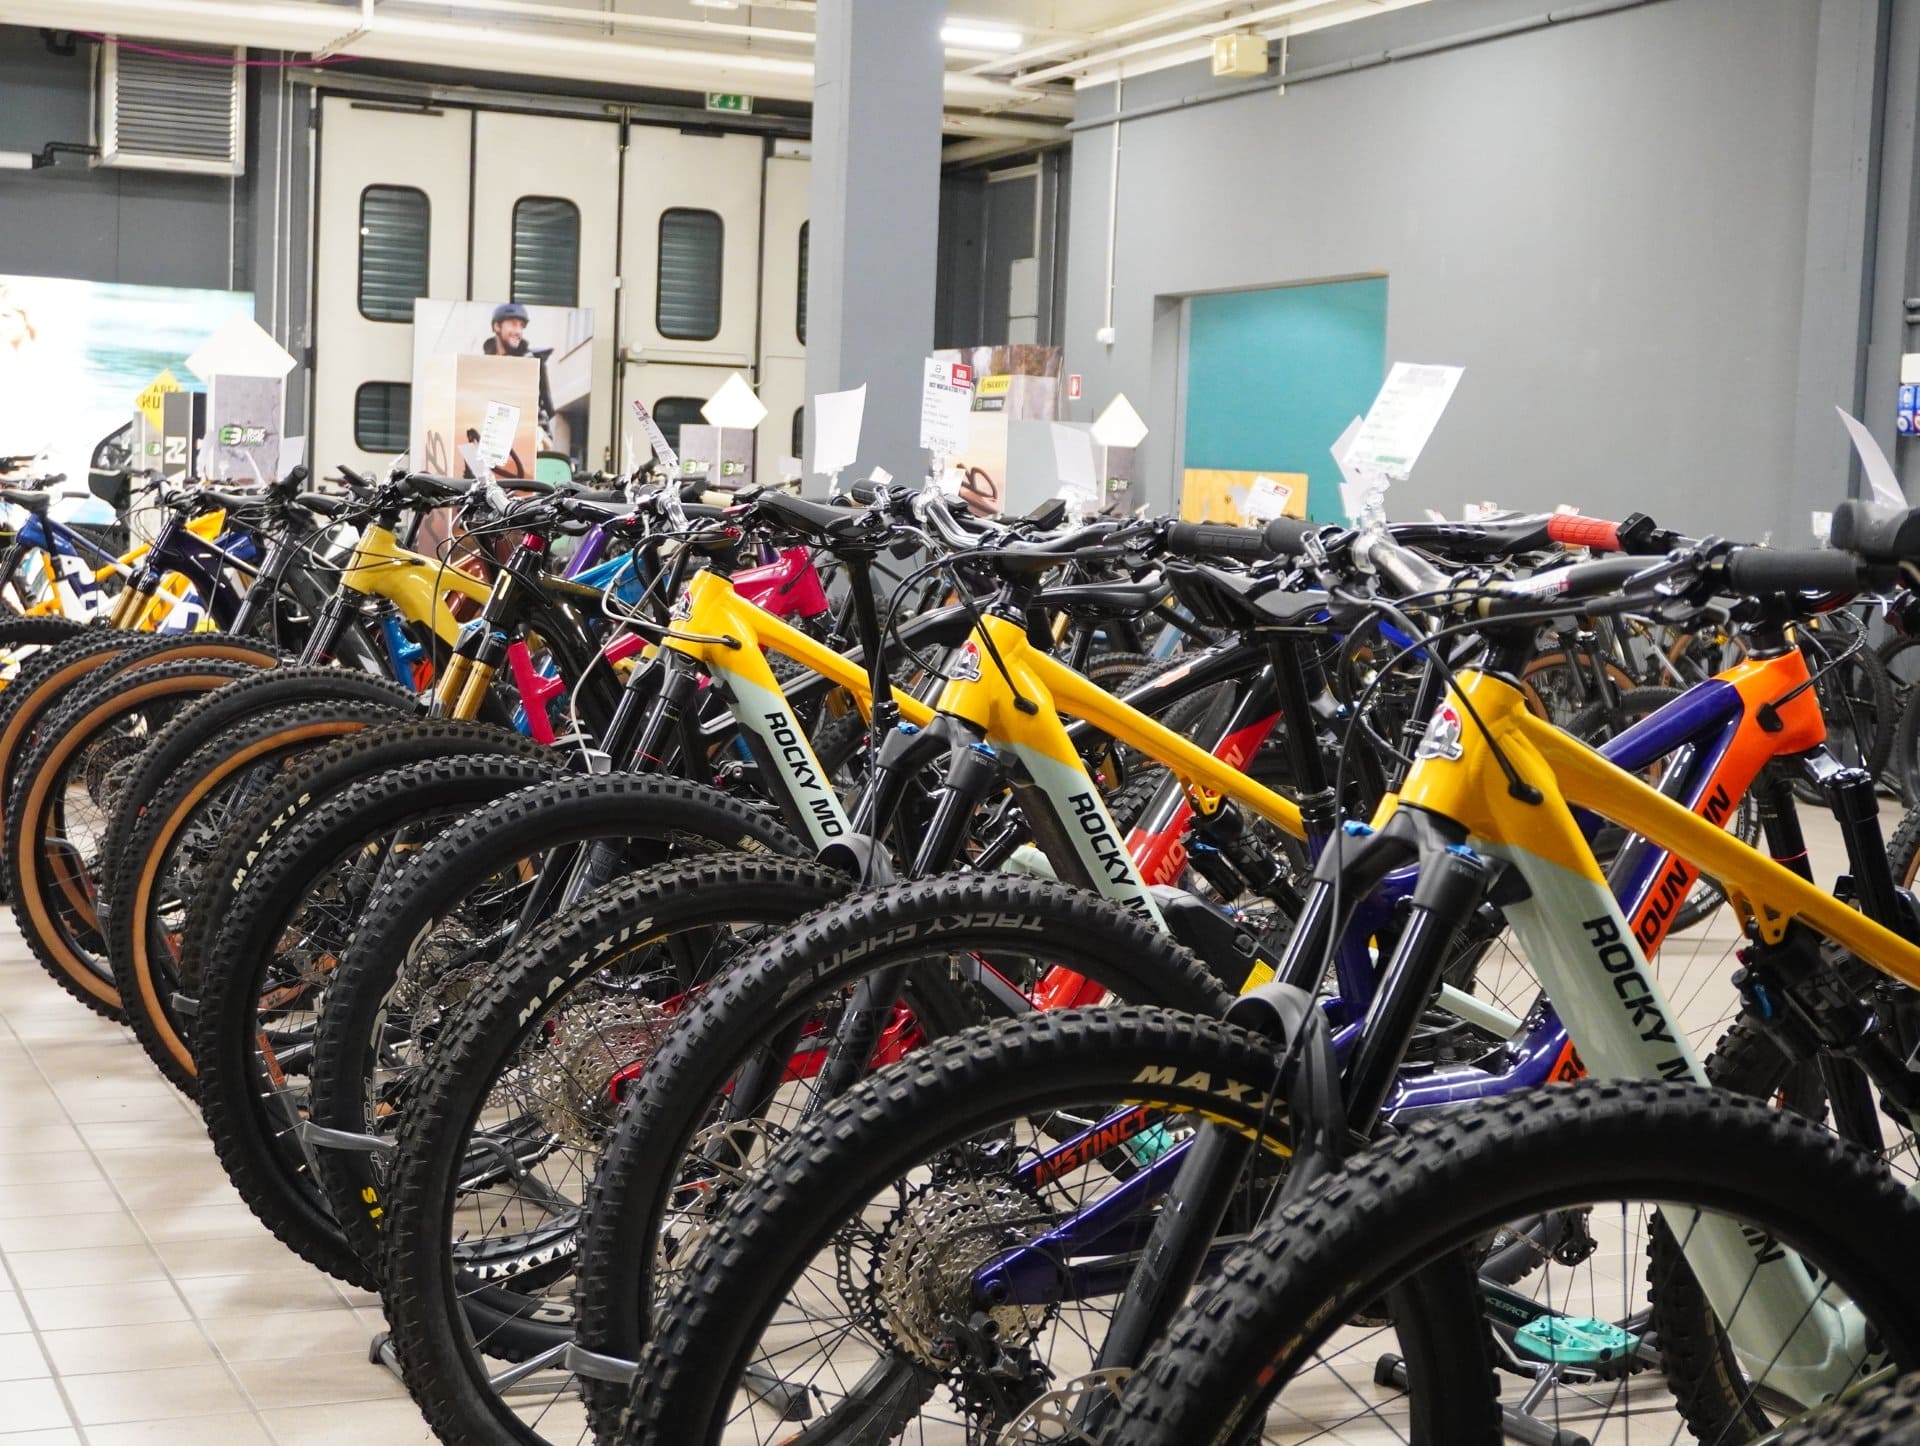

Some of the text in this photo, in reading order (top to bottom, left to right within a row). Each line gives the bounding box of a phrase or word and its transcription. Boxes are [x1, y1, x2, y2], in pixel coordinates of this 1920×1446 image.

[764, 711, 822, 790] ROCKY
[231, 792, 311, 892] MAXXIS
[1068, 792, 1136, 886] ROCKY
[924, 911, 1045, 936] TACKY
[518, 916, 655, 1027] MAXXIS
[1582, 914, 1677, 1043] ROCKY
[1035, 1104, 1151, 1190] INSTINCT
[465, 1232, 577, 1280] MAXXI
